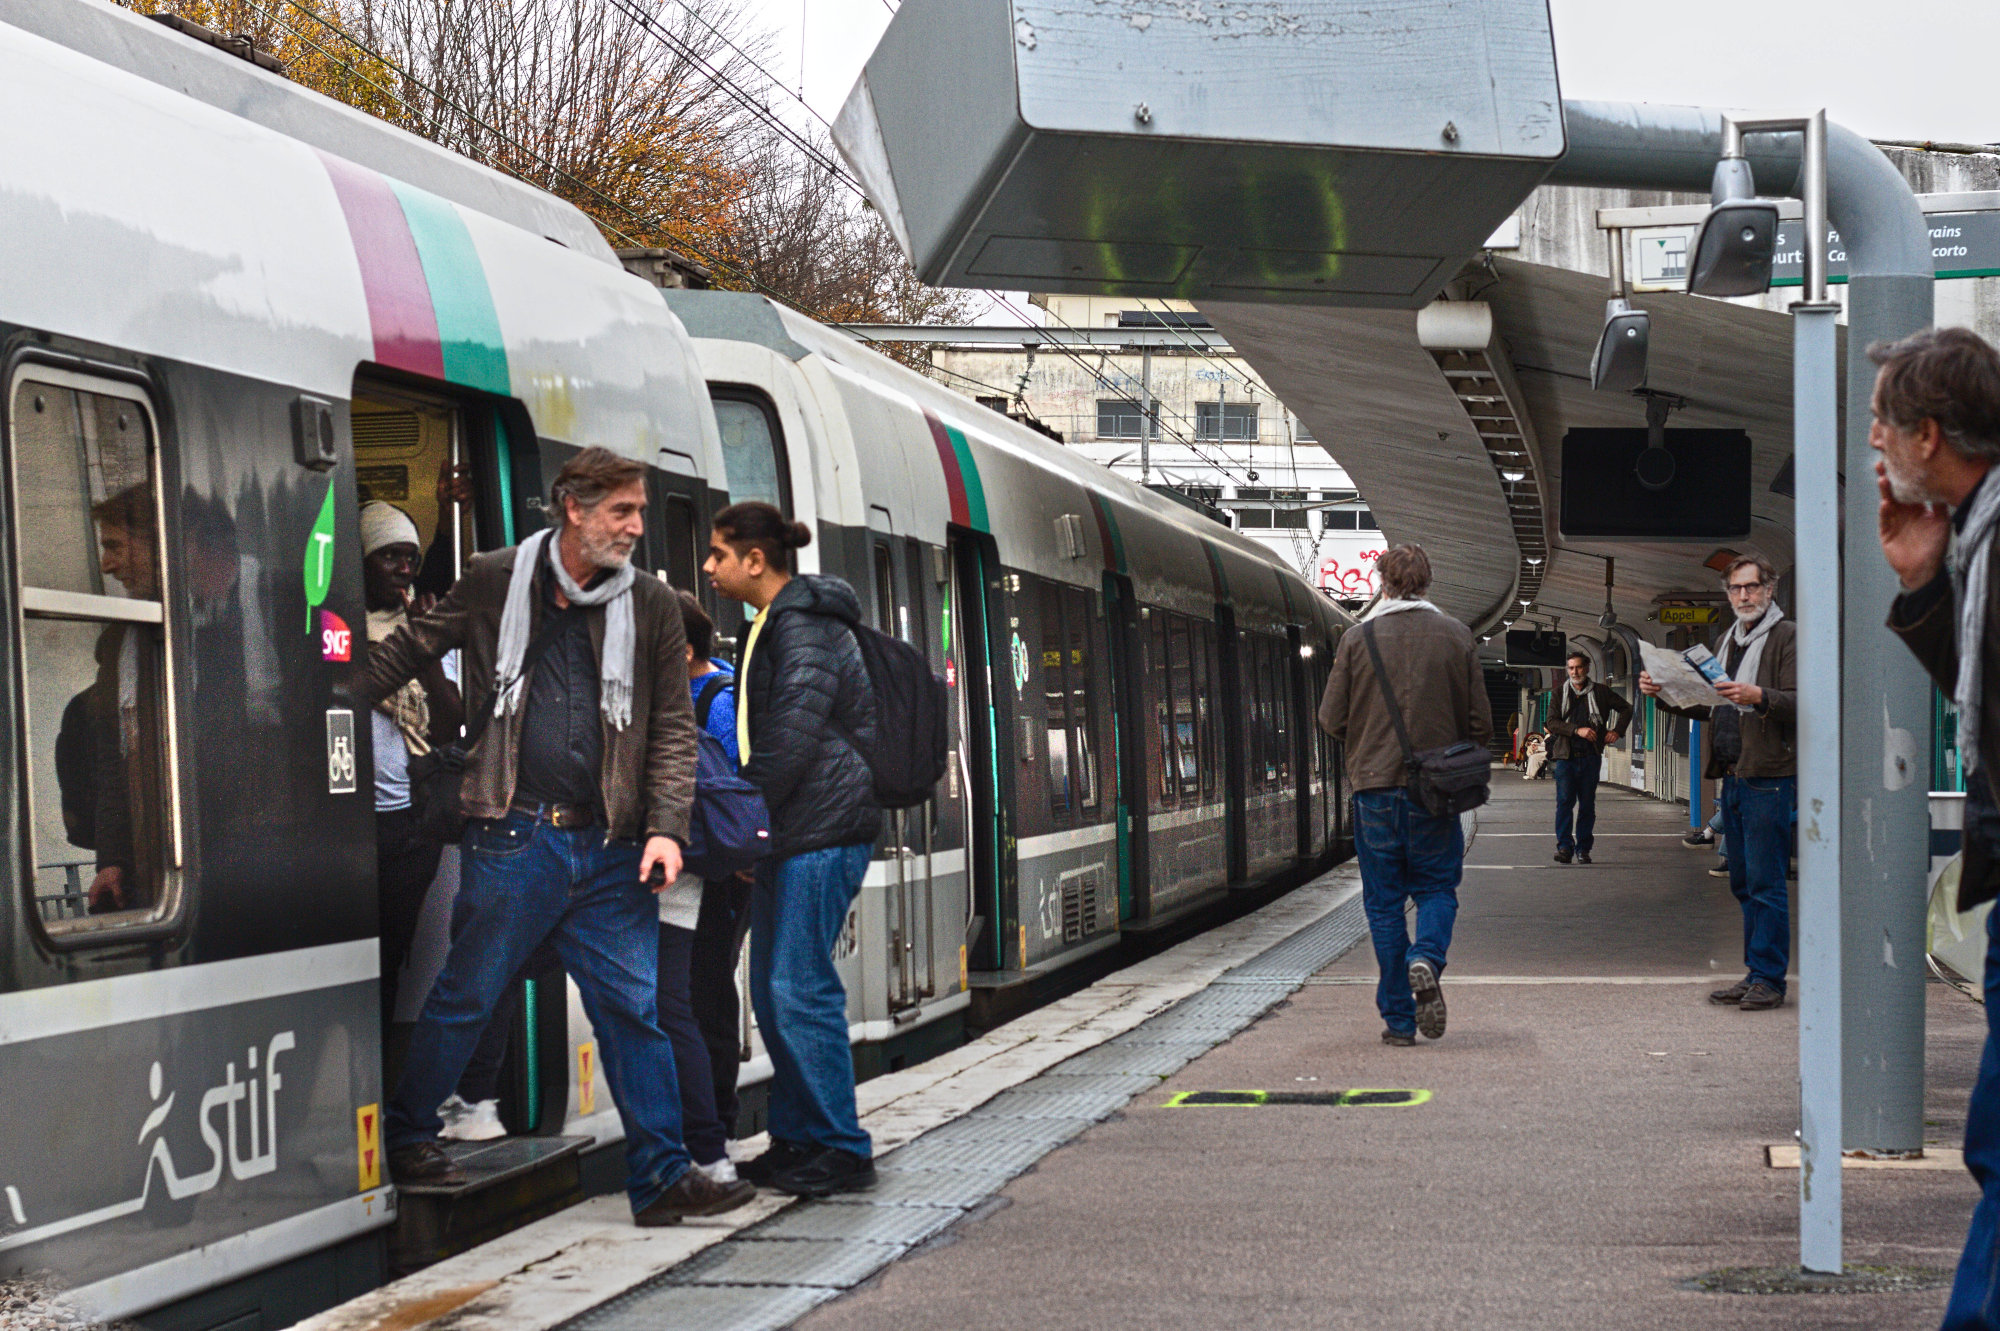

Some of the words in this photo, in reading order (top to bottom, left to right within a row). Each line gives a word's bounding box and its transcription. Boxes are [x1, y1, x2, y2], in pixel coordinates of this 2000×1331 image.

[1928, 225, 1961, 239] rains
[1932, 245, 1968, 257] corto
[1664, 611, 1695, 621] Appel
[322, 629, 350, 654] SNCF
